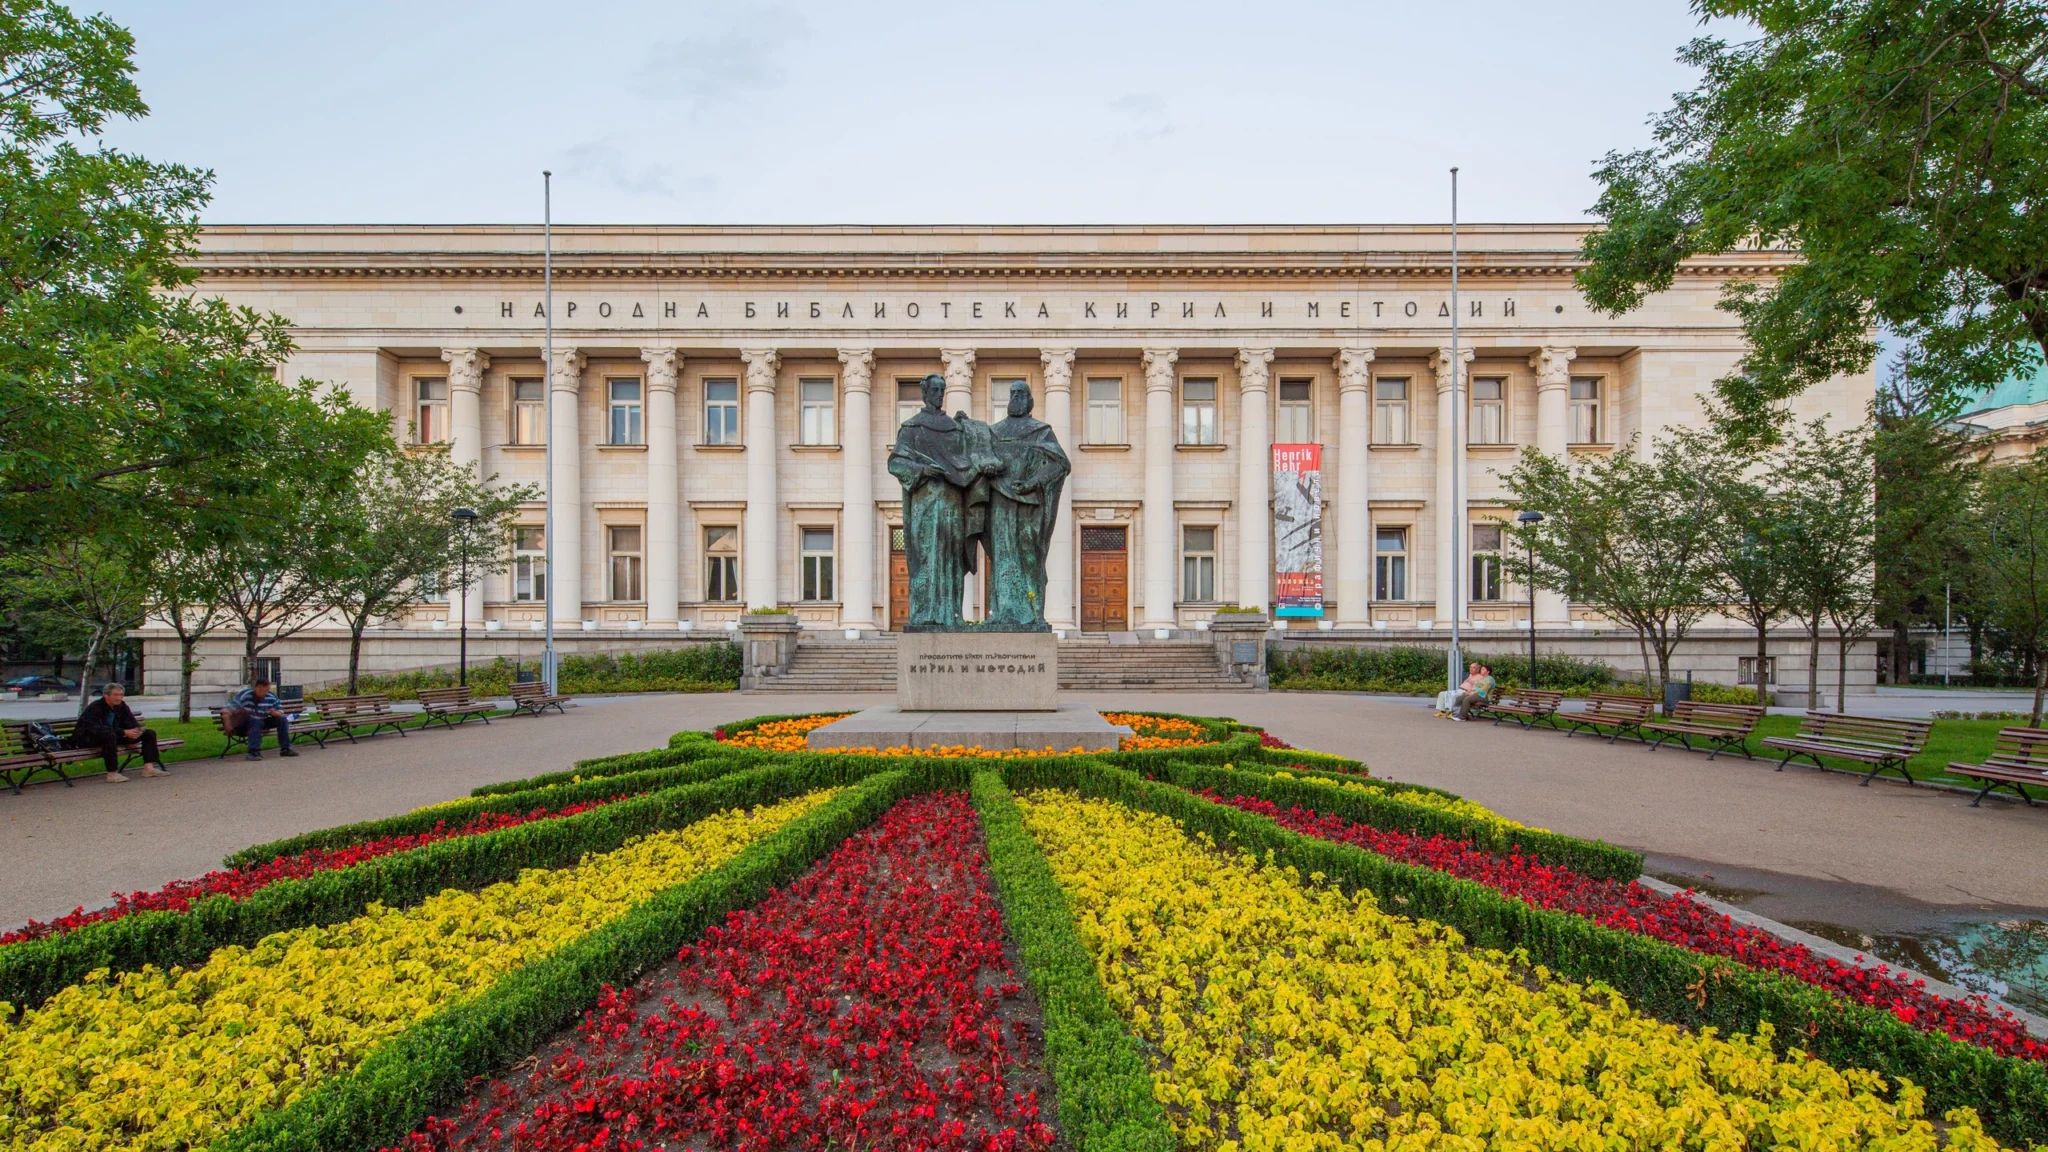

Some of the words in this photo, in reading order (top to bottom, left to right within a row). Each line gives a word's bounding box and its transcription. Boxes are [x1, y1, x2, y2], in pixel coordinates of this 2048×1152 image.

[501, 301, 709, 319] НАРОДНА
[745, 301, 1049, 318] БИБЛИОТЕКА
[1084, 301, 1227, 318] КИРИЛ
[1261, 301, 1273, 318] И
[1307, 297, 1516, 318] МЕТОДИЙ
[1274, 448, 1312, 461] Henrik
[1274, 460, 1301, 472] Rehr
[909, 662, 955, 673] КИРИЛ
[960, 664, 969, 673] И
[975, 662, 1046, 674] МЕТОДИЙ
